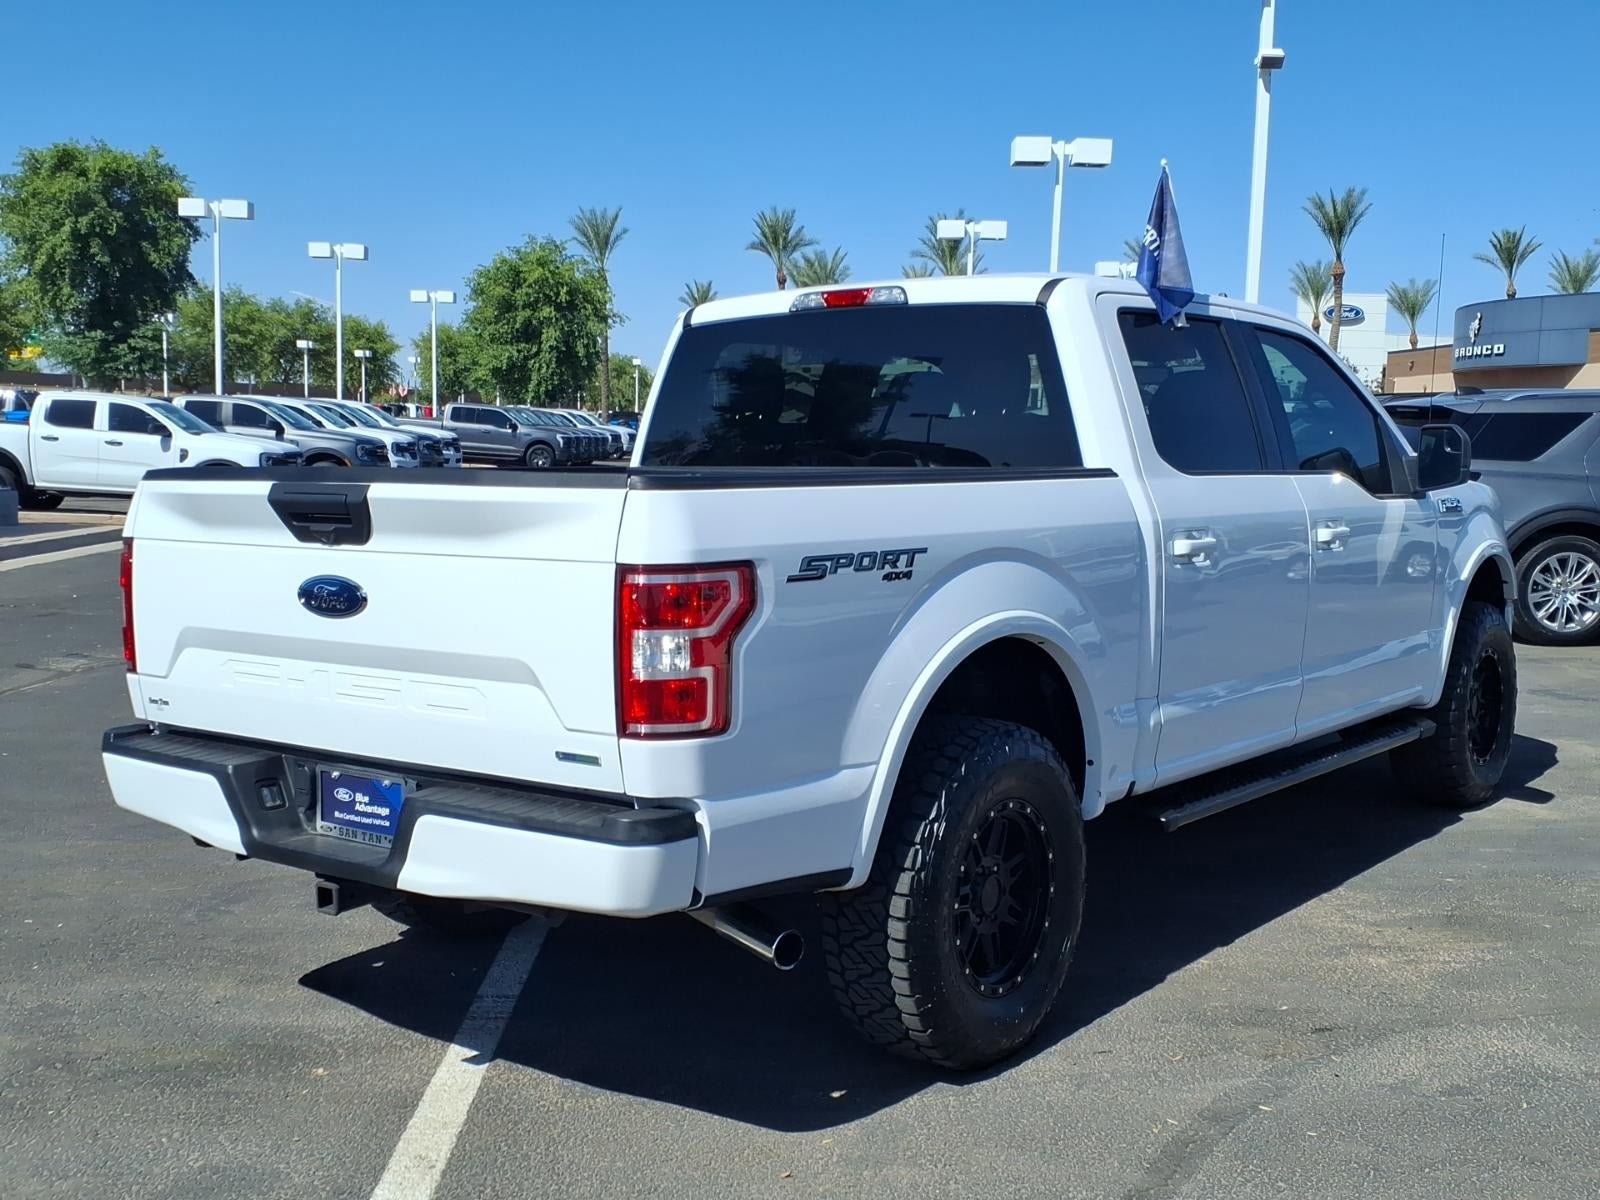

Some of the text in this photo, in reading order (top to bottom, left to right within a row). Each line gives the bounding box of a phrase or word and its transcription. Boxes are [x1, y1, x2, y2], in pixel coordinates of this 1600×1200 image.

[1455, 344, 1504, 358] BRONCO
[786, 547, 928, 584] SPORT
[355, 793, 369, 803] Blue
[355, 802, 390, 816] Advantage
[338, 827, 358, 839] SAN
[361, 831, 382, 845] TAN
